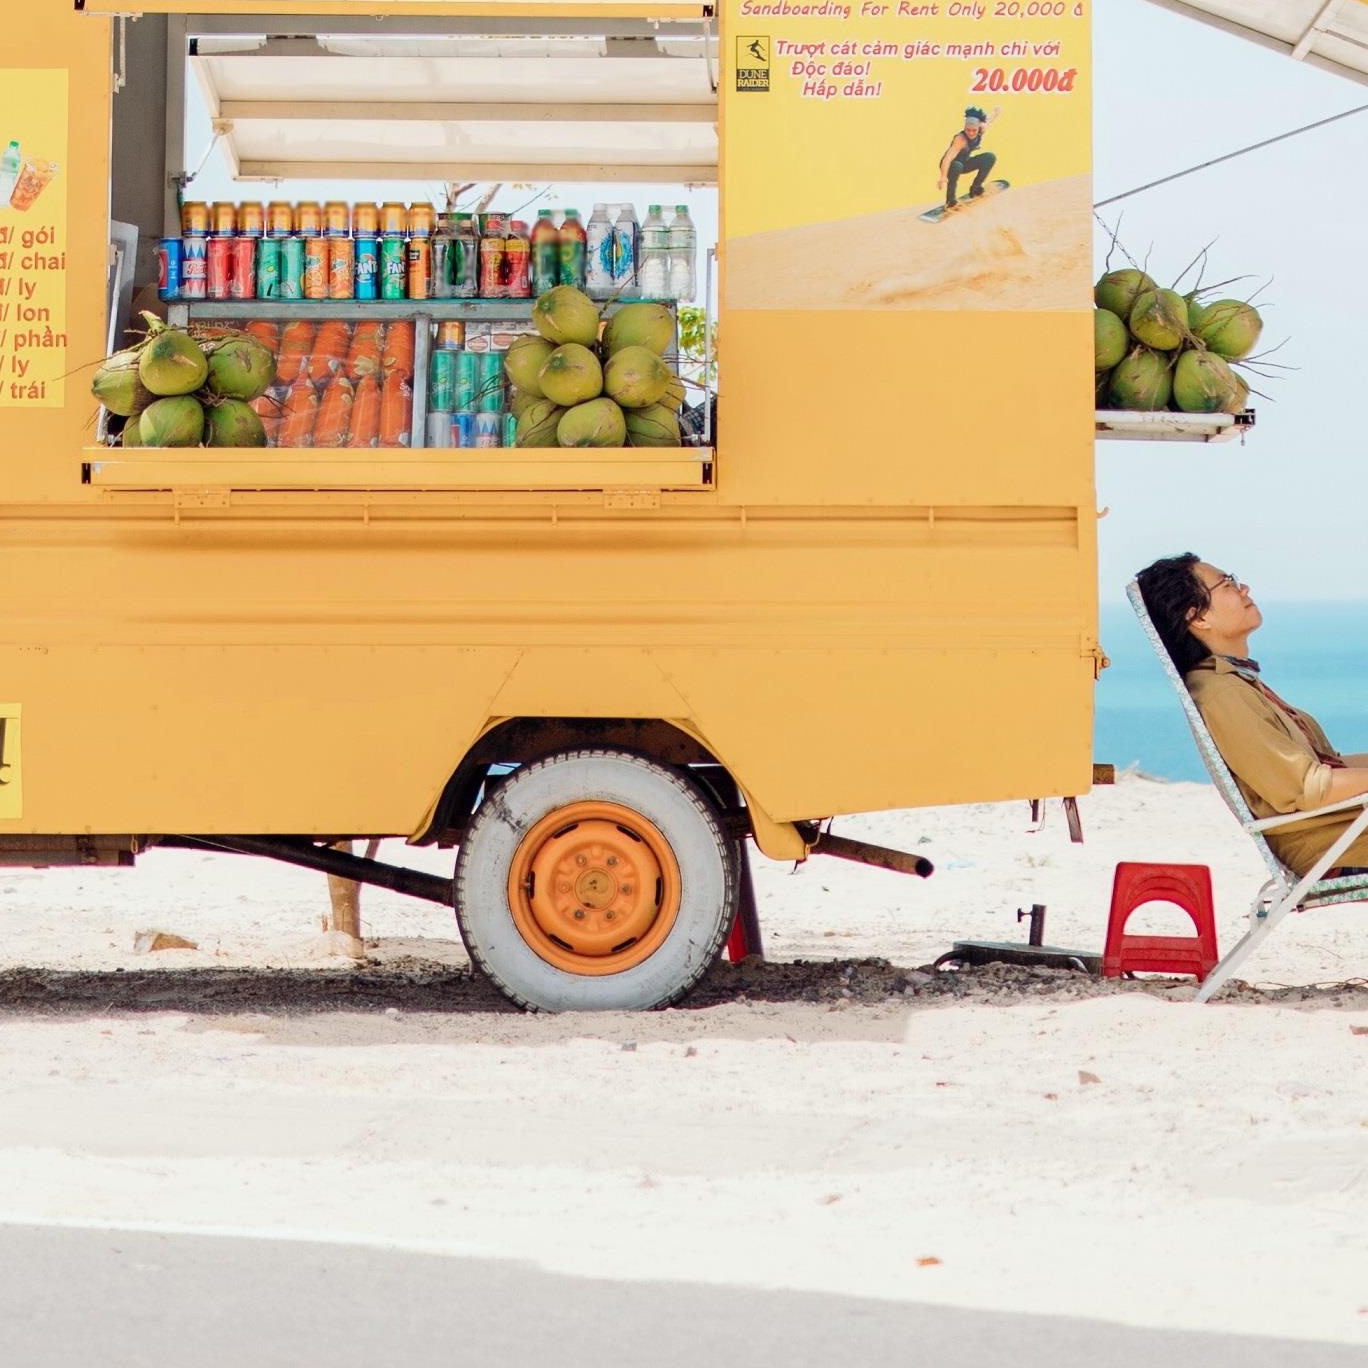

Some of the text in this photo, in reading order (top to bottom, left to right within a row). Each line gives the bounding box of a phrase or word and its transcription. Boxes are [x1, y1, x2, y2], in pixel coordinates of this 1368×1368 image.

[741, 0, 851, 18] Sandboarding
[862, 1, 888, 17] For
[898, 1, 938, 16] Rent
[948, 2, 985, 20] Only
[994, 2, 1064, 18] 20,000
[777, 40, 826, 58] Trượt
[830, 41, 858, 55] cát
[862, 41, 898, 55] cảm
[904, 41, 940, 59] giác
[946, 41, 995, 59] mạnh
[1033, 41, 1061, 56] với
[740, 70, 767, 78] DUNE
[792, 61, 871, 78] Độc đáo!
[738, 79, 768, 87] RAIDER
[803, 79, 882, 99] Hấp dẫn!
[972, 68, 1078, 92] 20.000đ
[22, 226, 55, 248] gói
[21, 252, 66, 270] chai
[18, 278, 37, 300] ly
[17, 303, 50, 321] lon
[14, 326, 68, 351] phần
[12, 355, 29, 377] ly
[11, 381, 46, 399] trái
